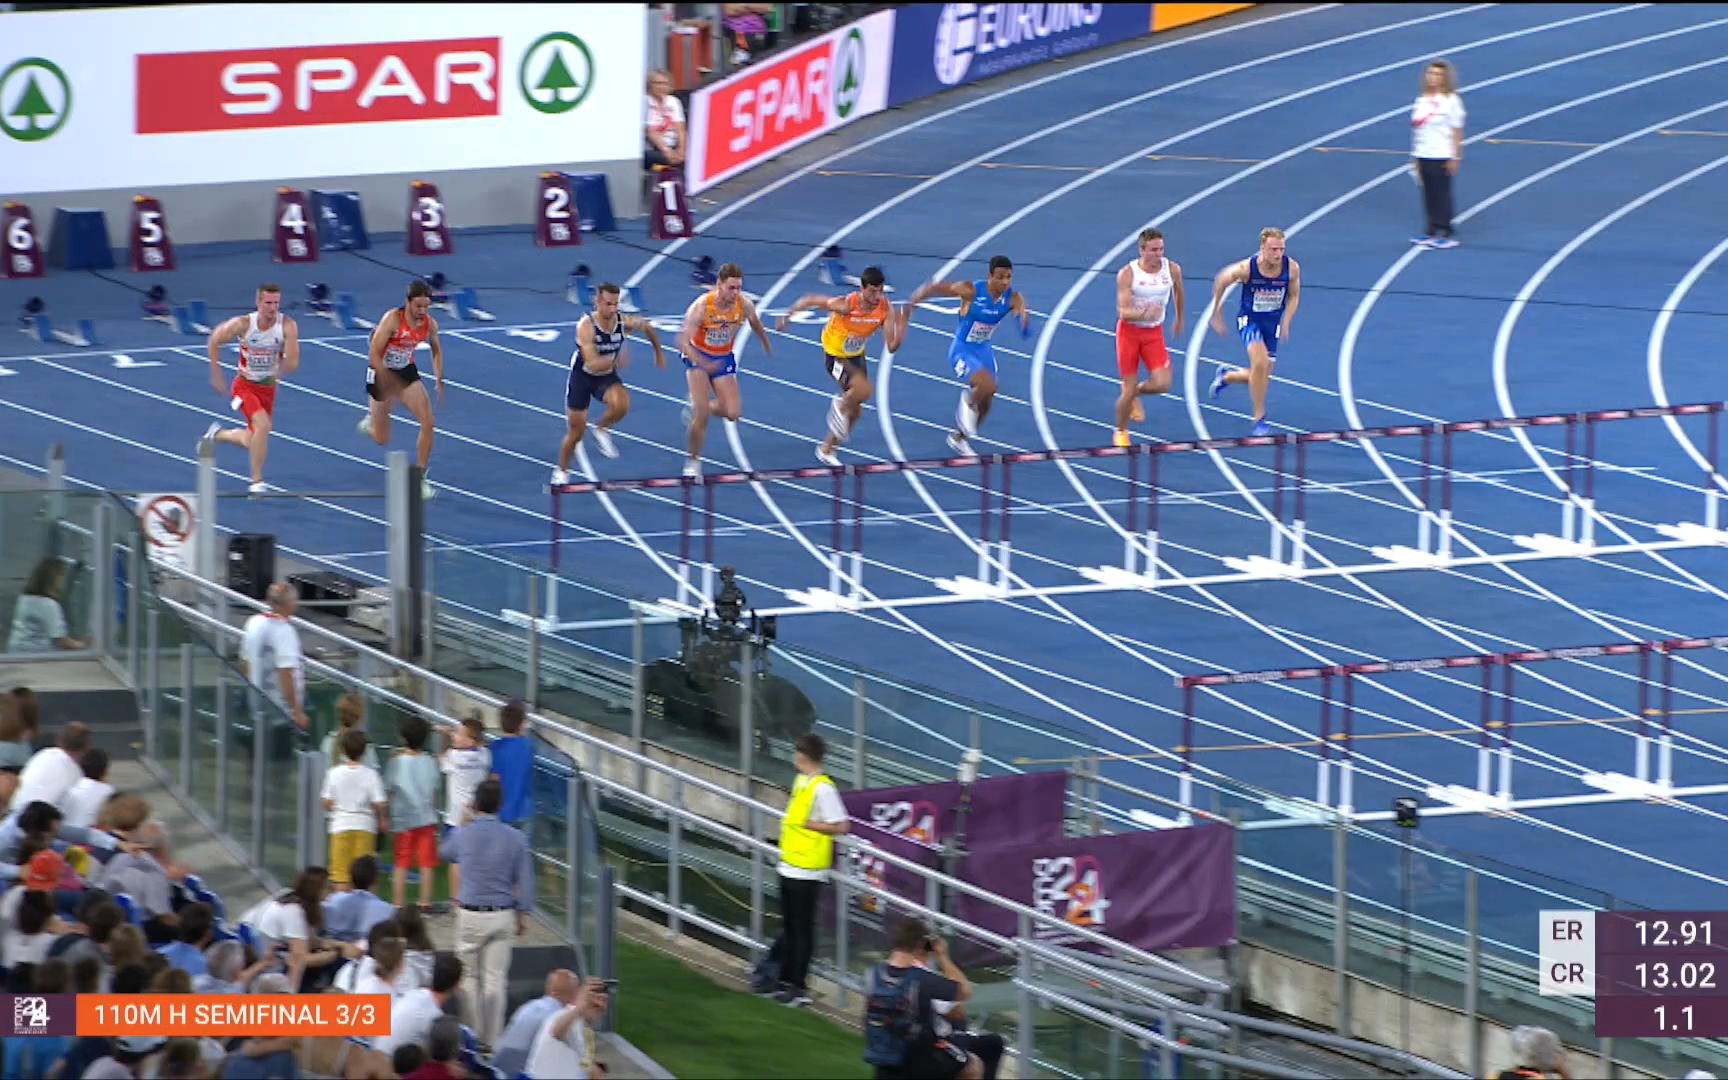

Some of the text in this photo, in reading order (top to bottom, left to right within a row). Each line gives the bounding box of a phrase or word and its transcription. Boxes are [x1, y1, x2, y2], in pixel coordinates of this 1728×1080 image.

[220, 51, 496, 115] SPAR
[729, 57, 830, 152] SPAR
[544, 187, 570, 219] 2
[658, 181, 678, 210] 1
[140, 212, 163, 242] 5
[281, 203, 307, 234] 4
[418, 197, 443, 227] 3
[8, 217, 33, 251] 6
